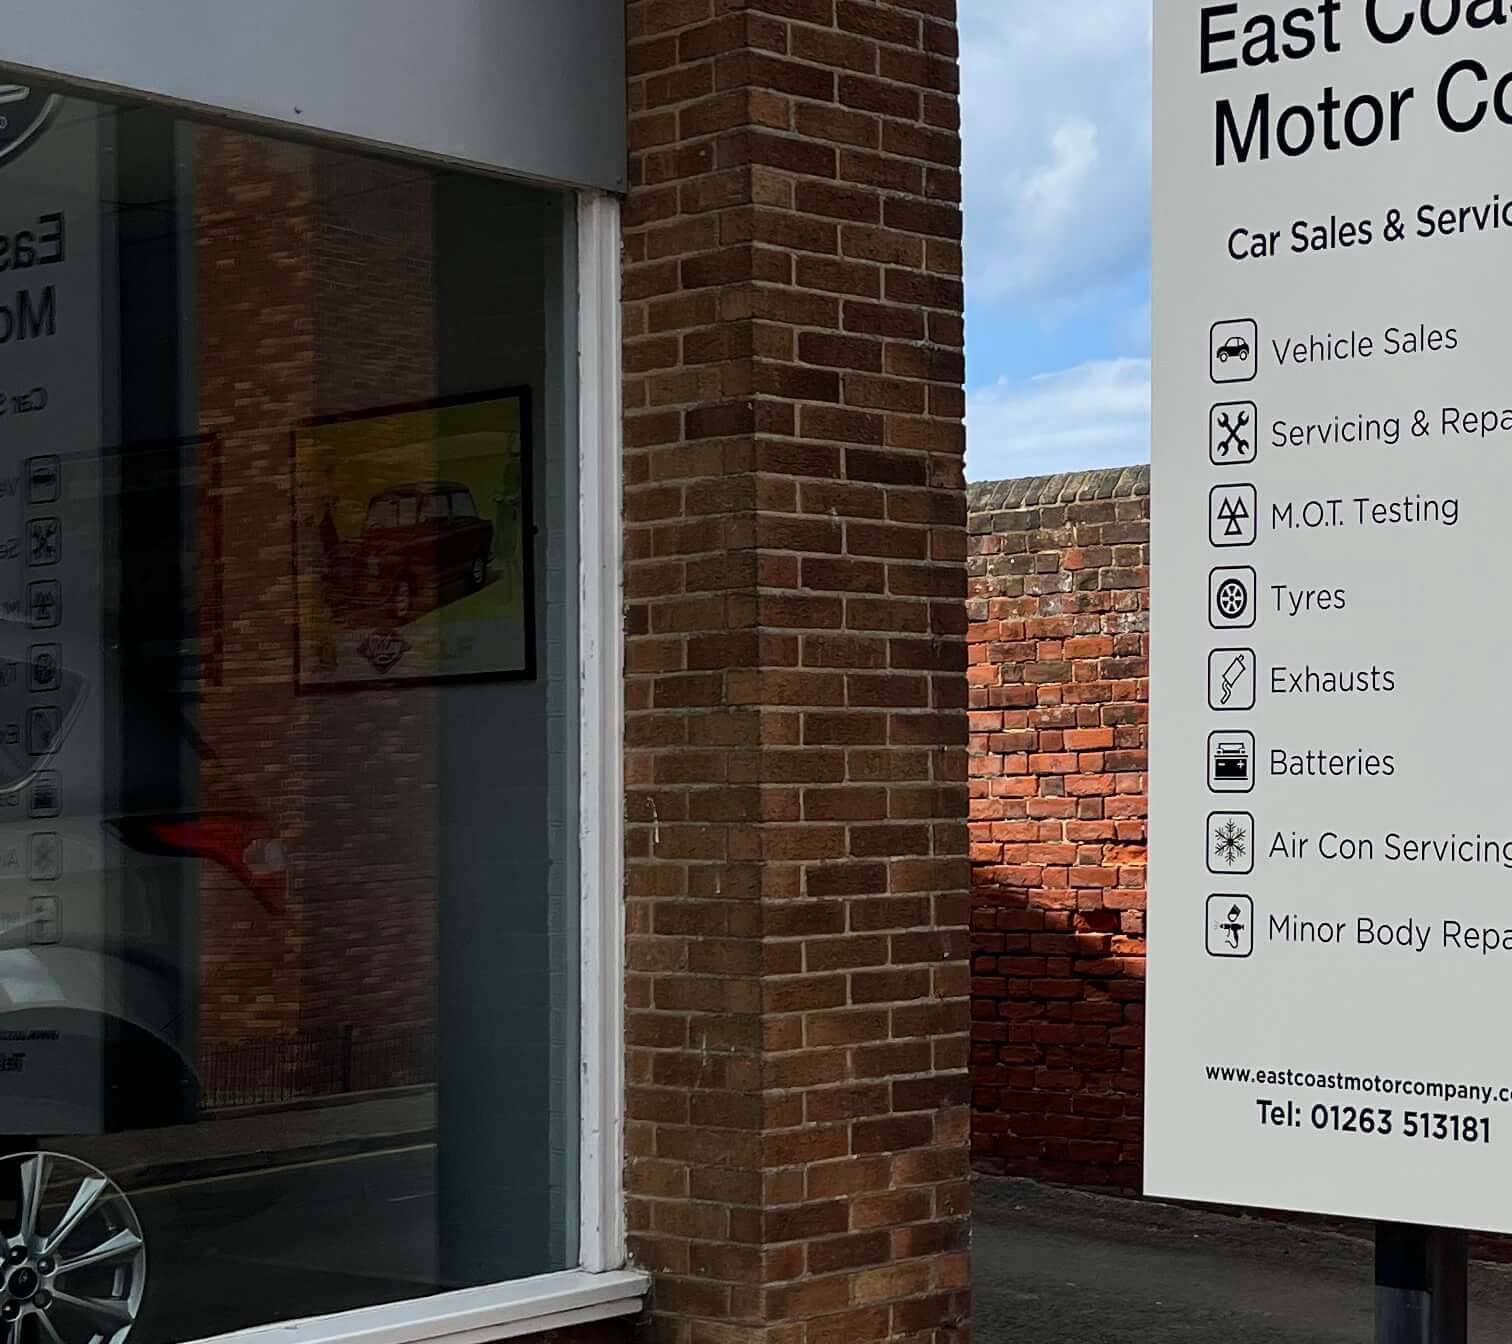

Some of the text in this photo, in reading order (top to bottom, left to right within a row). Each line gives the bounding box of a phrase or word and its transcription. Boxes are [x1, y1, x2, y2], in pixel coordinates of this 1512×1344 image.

[1215, 86, 1414, 167] Motor
[1227, 227, 1281, 261] Car
[1290, 215, 1373, 253] Sales
[1383, 208, 1406, 242] &
[1271, 323, 1458, 366] Vehicle Sales
[1271, 413, 1400, 448] Servicing
[1410, 409, 1430, 438] &
[1272, 493, 1459, 530] M.O.T. Testing
[1271, 584, 1346, 617] Tyres
[1271, 664, 1395, 694] Exhausts
[1271, 747, 1395, 776] Batteries
[1269, 831, 1309, 859] Air
[1318, 831, 1373, 860] Con
[1269, 913, 1347, 944] Minor
[1356, 916, 1432, 953] Body
[1256, 1098, 1490, 1144] Tel: 01263 513181
